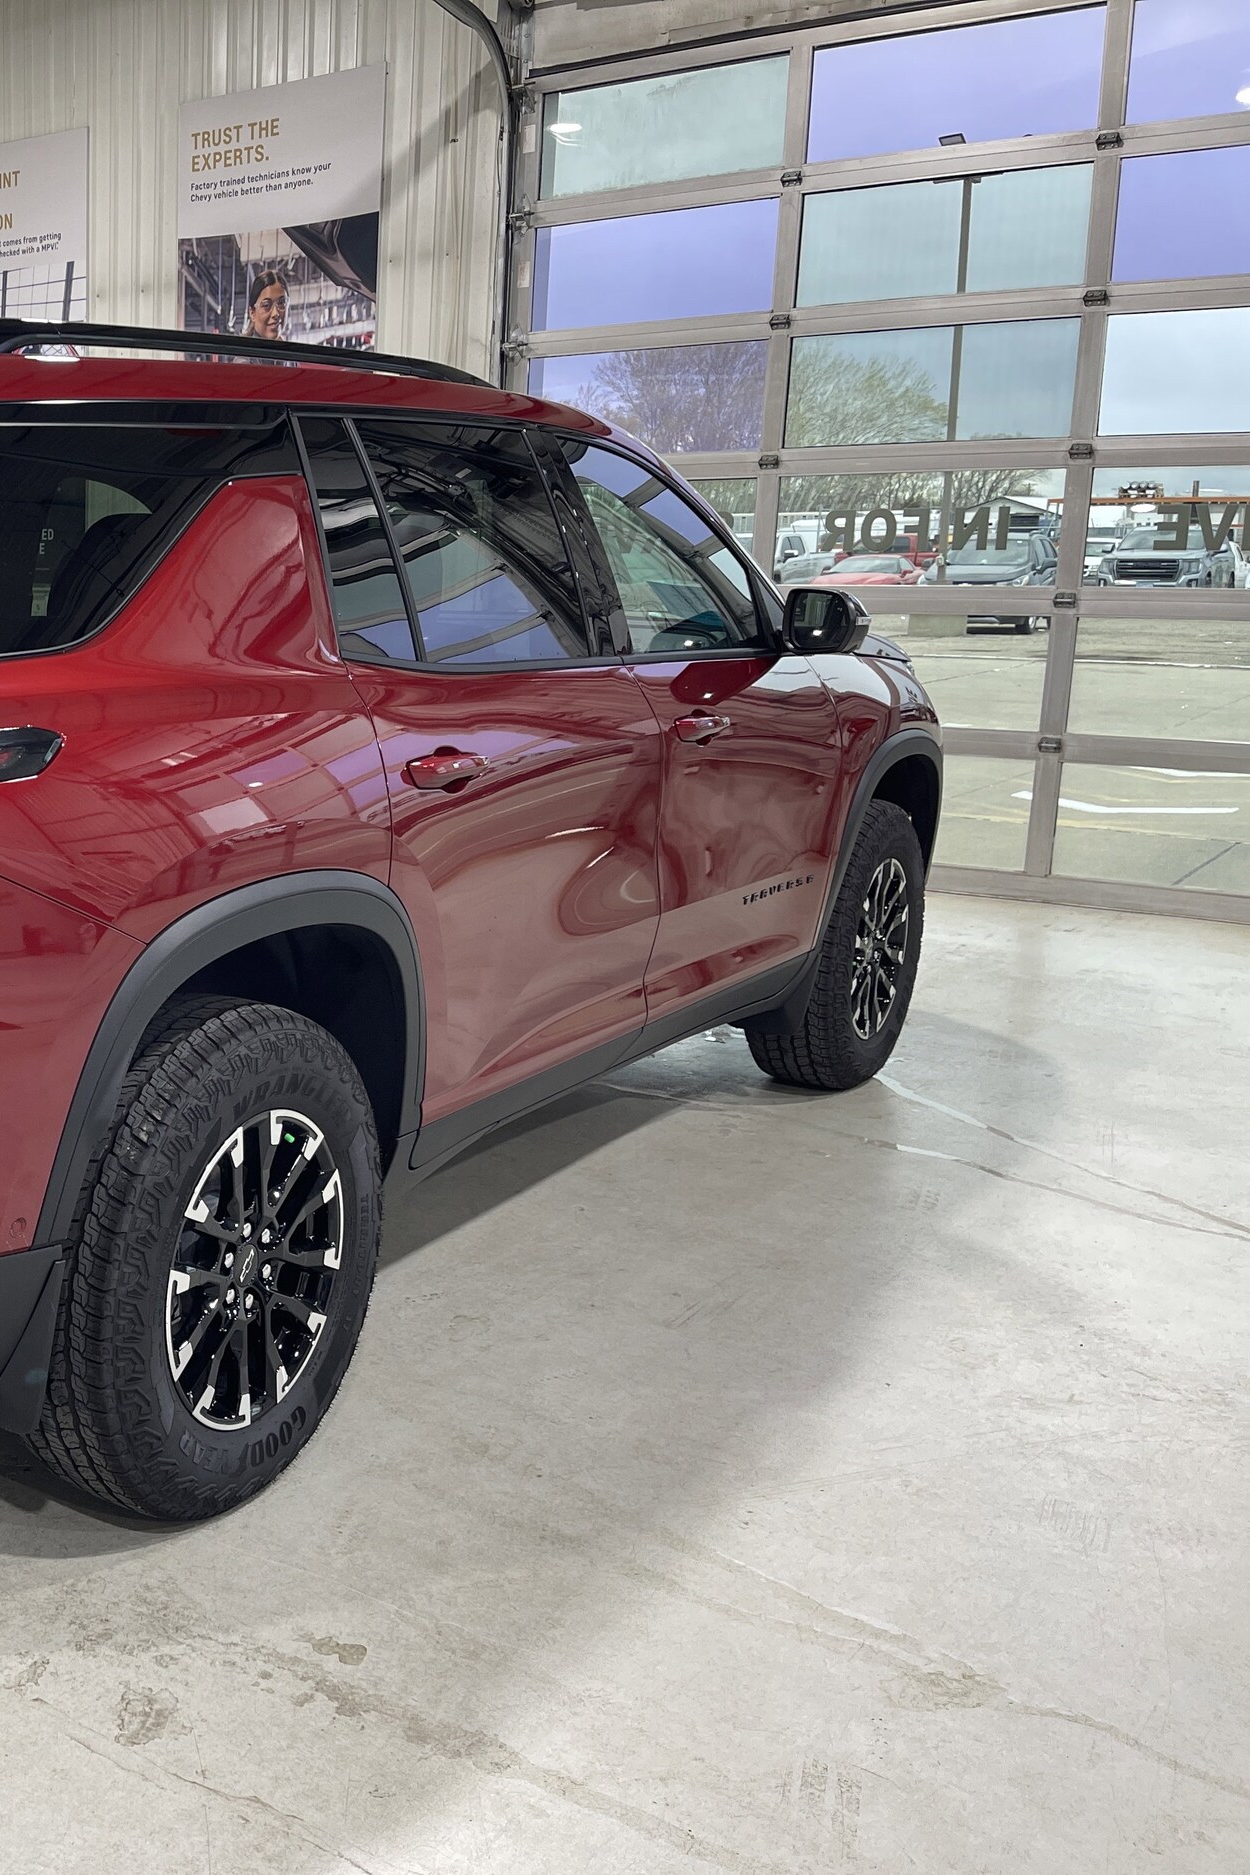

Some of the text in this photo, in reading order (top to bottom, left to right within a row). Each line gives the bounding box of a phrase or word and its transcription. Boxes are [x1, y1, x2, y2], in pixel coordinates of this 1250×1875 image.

[191, 118, 280, 150] TRUST THE
[191, 144, 269, 172] EXPERTS.
[190, 162, 332, 192] Factory trained technicians know your
[190, 179, 314, 203] Chevy vehicle better than anyone.
[2, 238, 22, 247] comes
[23, 236, 38, 245] from
[39, 232, 62, 244] getting
[21, 246, 35, 256] with
[742, 874, 814, 906] TRAVERSE
